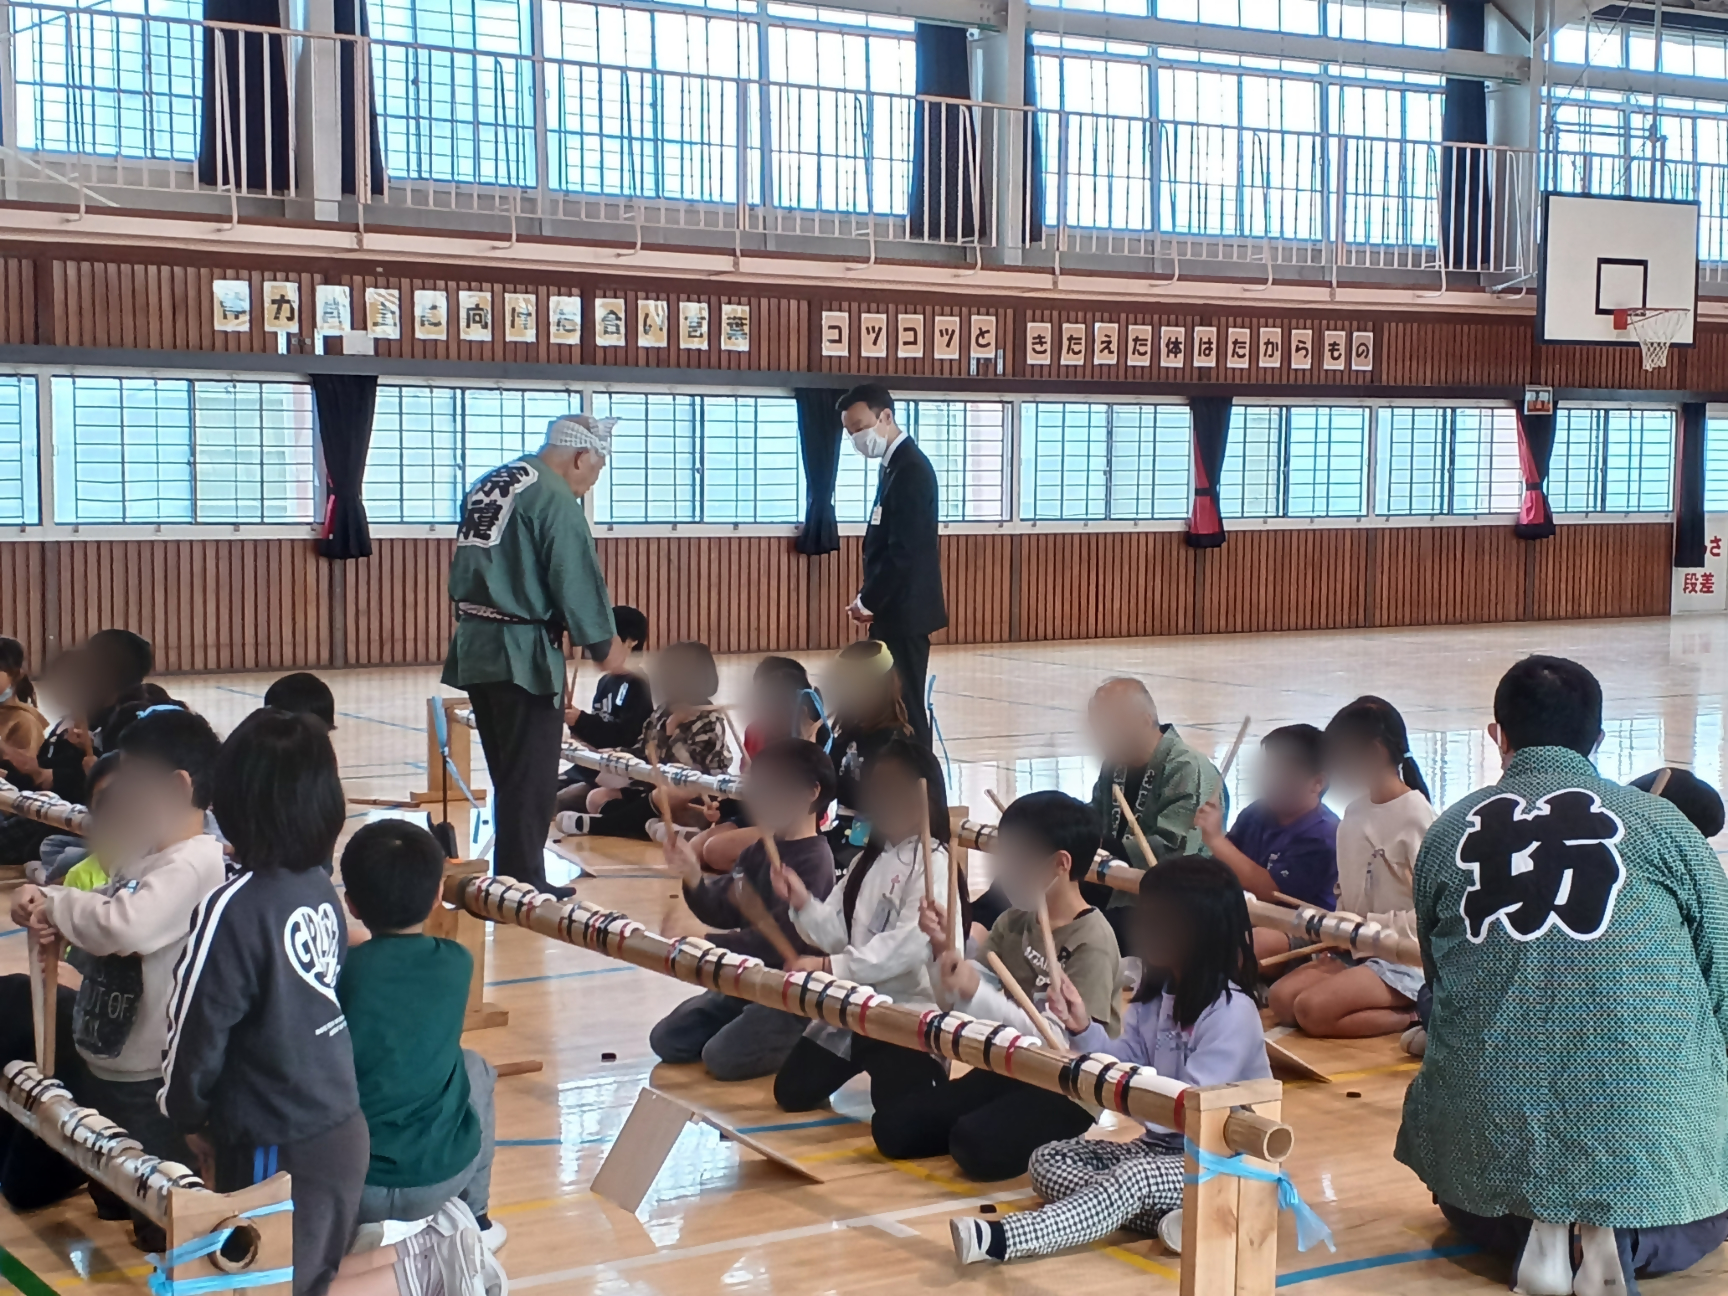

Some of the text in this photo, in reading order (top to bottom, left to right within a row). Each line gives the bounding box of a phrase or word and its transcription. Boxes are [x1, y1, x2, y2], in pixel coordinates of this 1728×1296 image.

[826, 324, 1370, 361] コツコツと きたえた体はたからもの
[1682, 571, 1715, 594] 段差
[1457, 789, 1625, 942] 坊
